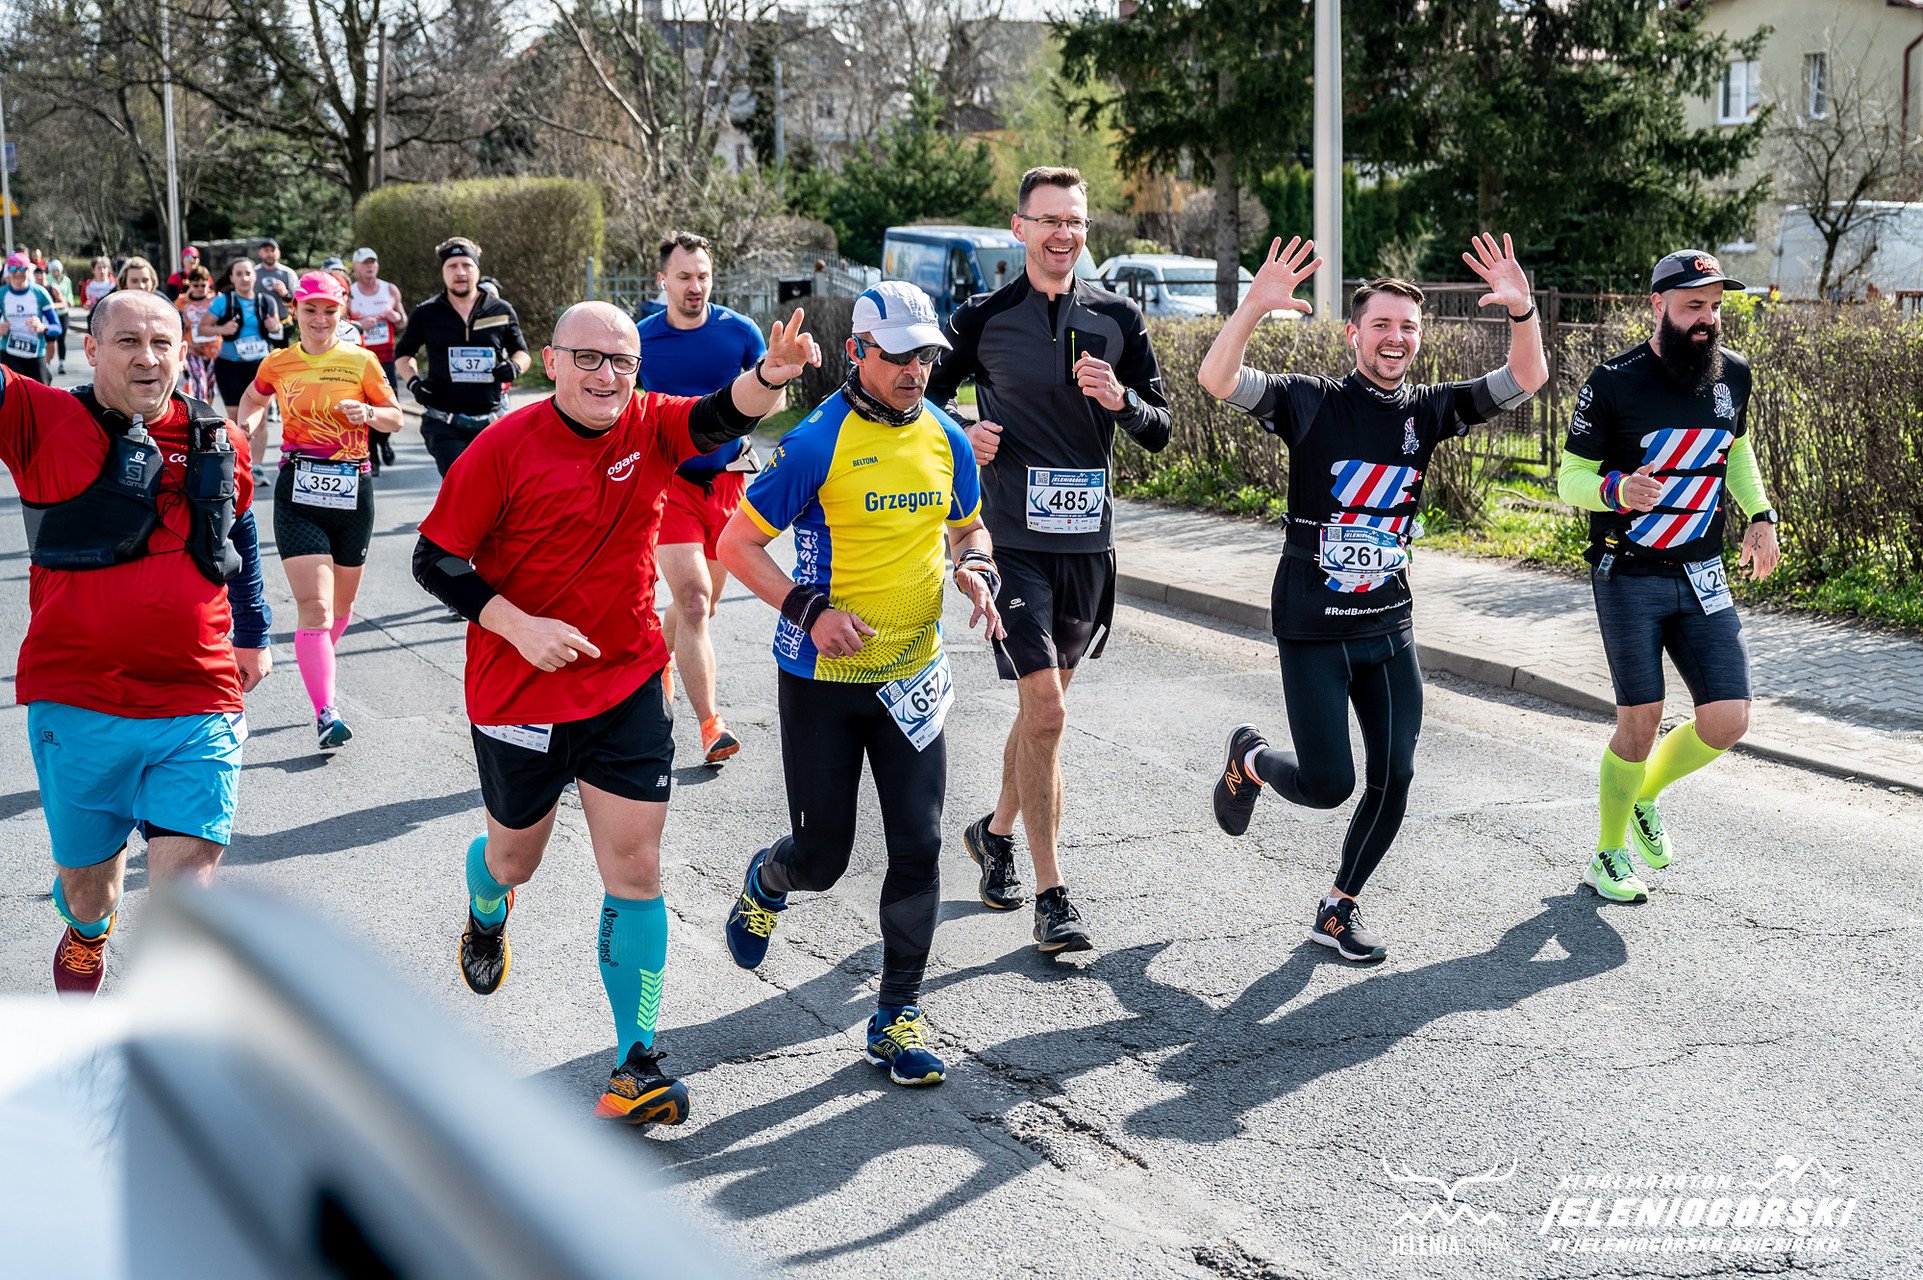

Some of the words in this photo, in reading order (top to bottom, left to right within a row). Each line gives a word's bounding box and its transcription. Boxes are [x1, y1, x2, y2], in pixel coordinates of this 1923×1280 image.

[465, 359, 481, 370] 37
[169, 453, 187, 463] Co
[608, 451, 641, 473] ogate
[852, 456, 879, 467] BELTONA
[310, 475, 341, 492] 352
[865, 491, 944, 513] Grzegorz
[1048, 490, 1088, 511] 485
[797, 528, 812, 586] OLSKI
[1342, 545, 1384, 568] 261
[790, 629, 806, 660] ATLAN
[911, 671, 941, 713] 657
